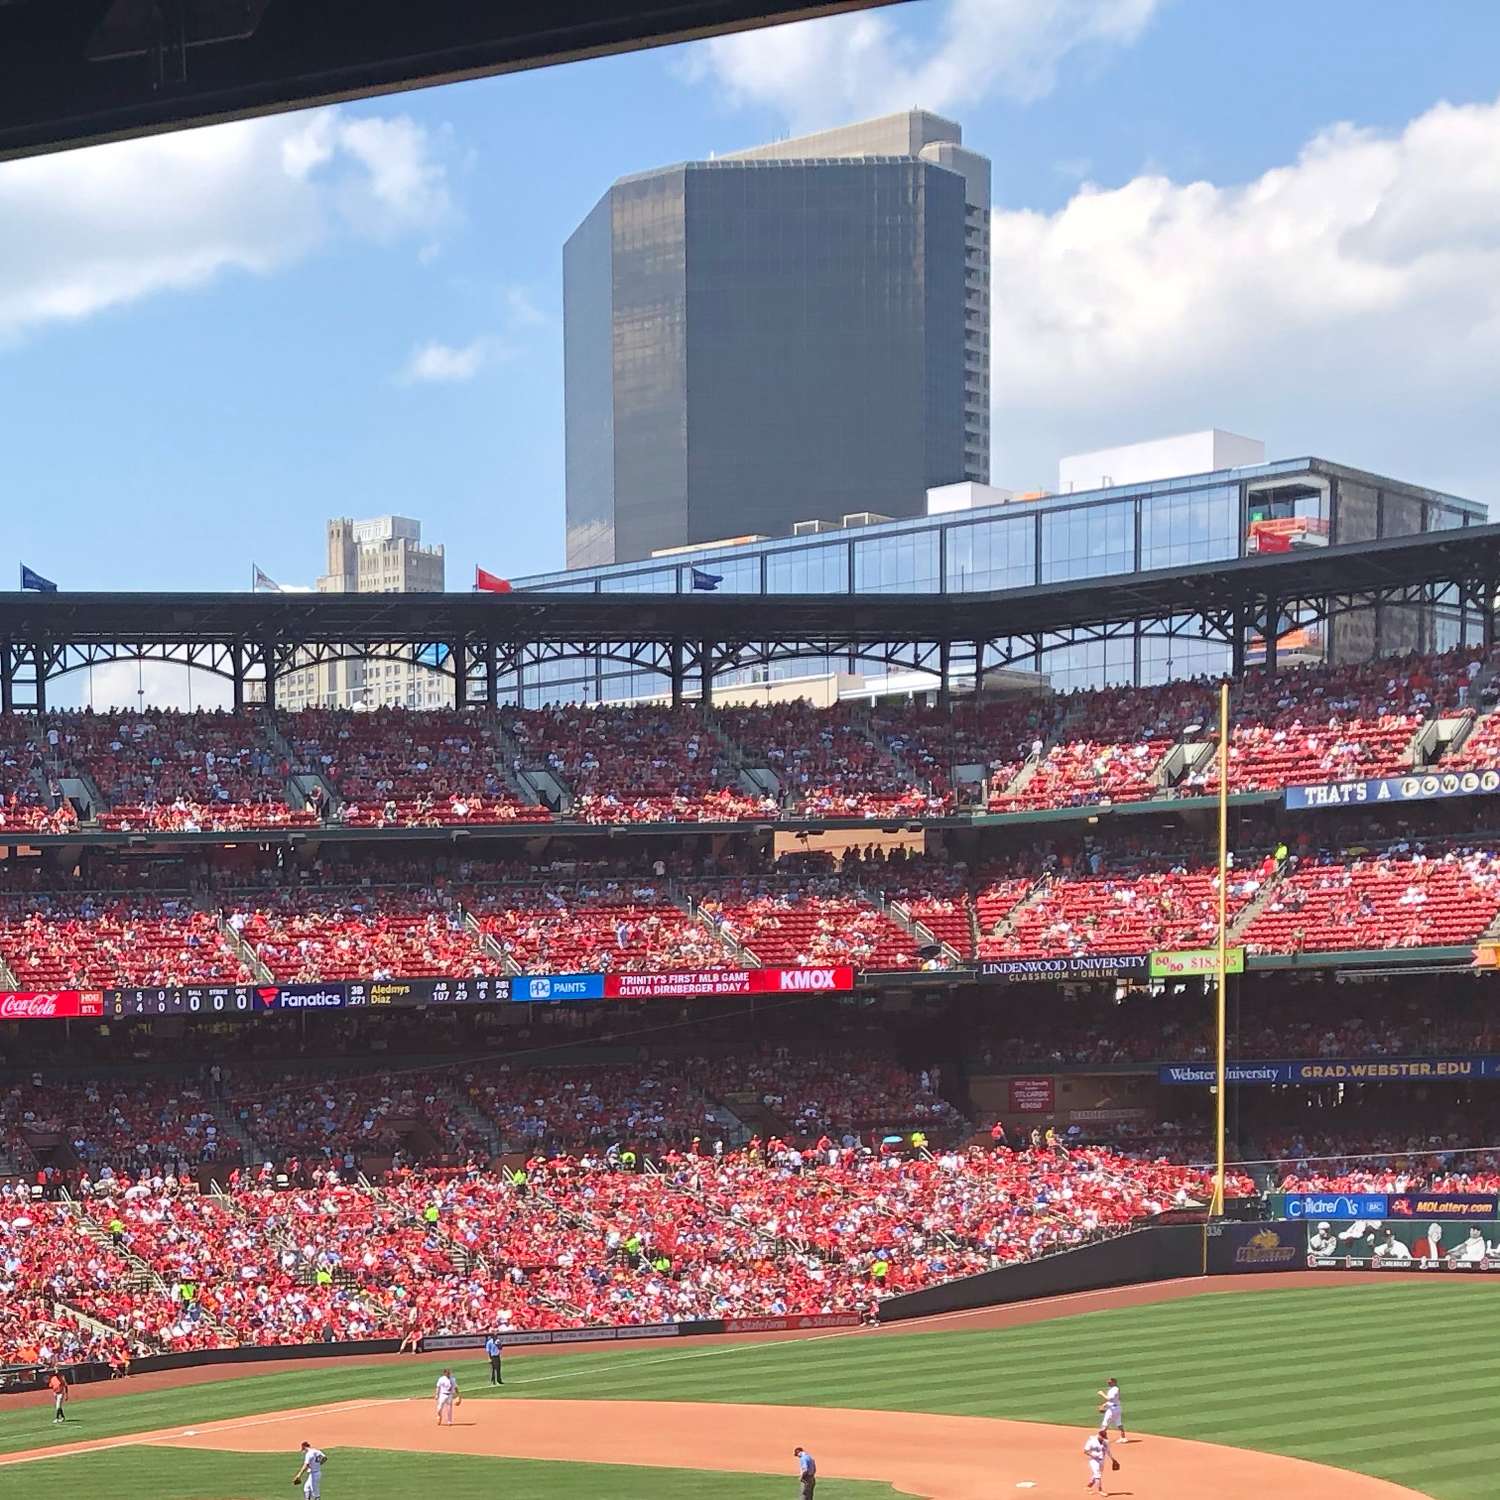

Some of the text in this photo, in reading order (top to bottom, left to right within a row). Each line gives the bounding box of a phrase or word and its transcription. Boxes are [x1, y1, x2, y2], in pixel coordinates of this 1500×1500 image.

[1305, 782, 1367, 805] THAT'S
[1377, 781, 1391, 800] A
[982, 956, 1147, 975] LINDENWOOD UNIVERSITY
[620, 975, 667, 985] TRINITY'S
[669, 974, 697, 984] FIRST
[721, 972, 750, 982] GAME
[781, 970, 836, 990] KMOX
[1081, 968, 1119, 978] ONLINE
[371, 984, 410, 996] Aledmys
[554, 982, 586, 993] PAINTS
[619, 982, 750, 996] OLIVIA DIRNBERGER BDAY 4
[81, 991, 165, 1003] HOU 2 5 0
[281, 991, 341, 1008] Fanatics
[432, 989, 509, 1001] 107 29 6 26
[81, 1002, 165, 1014] STL 0 4 0
[189, 994, 247, 1011] 0 0 0
[1169, 1066, 1216, 1081] Webster
[1300, 1062, 1471, 1078] GRAD.WEBSTER.EDU
[1417, 1200, 1493, 1214] MOLottery.com
